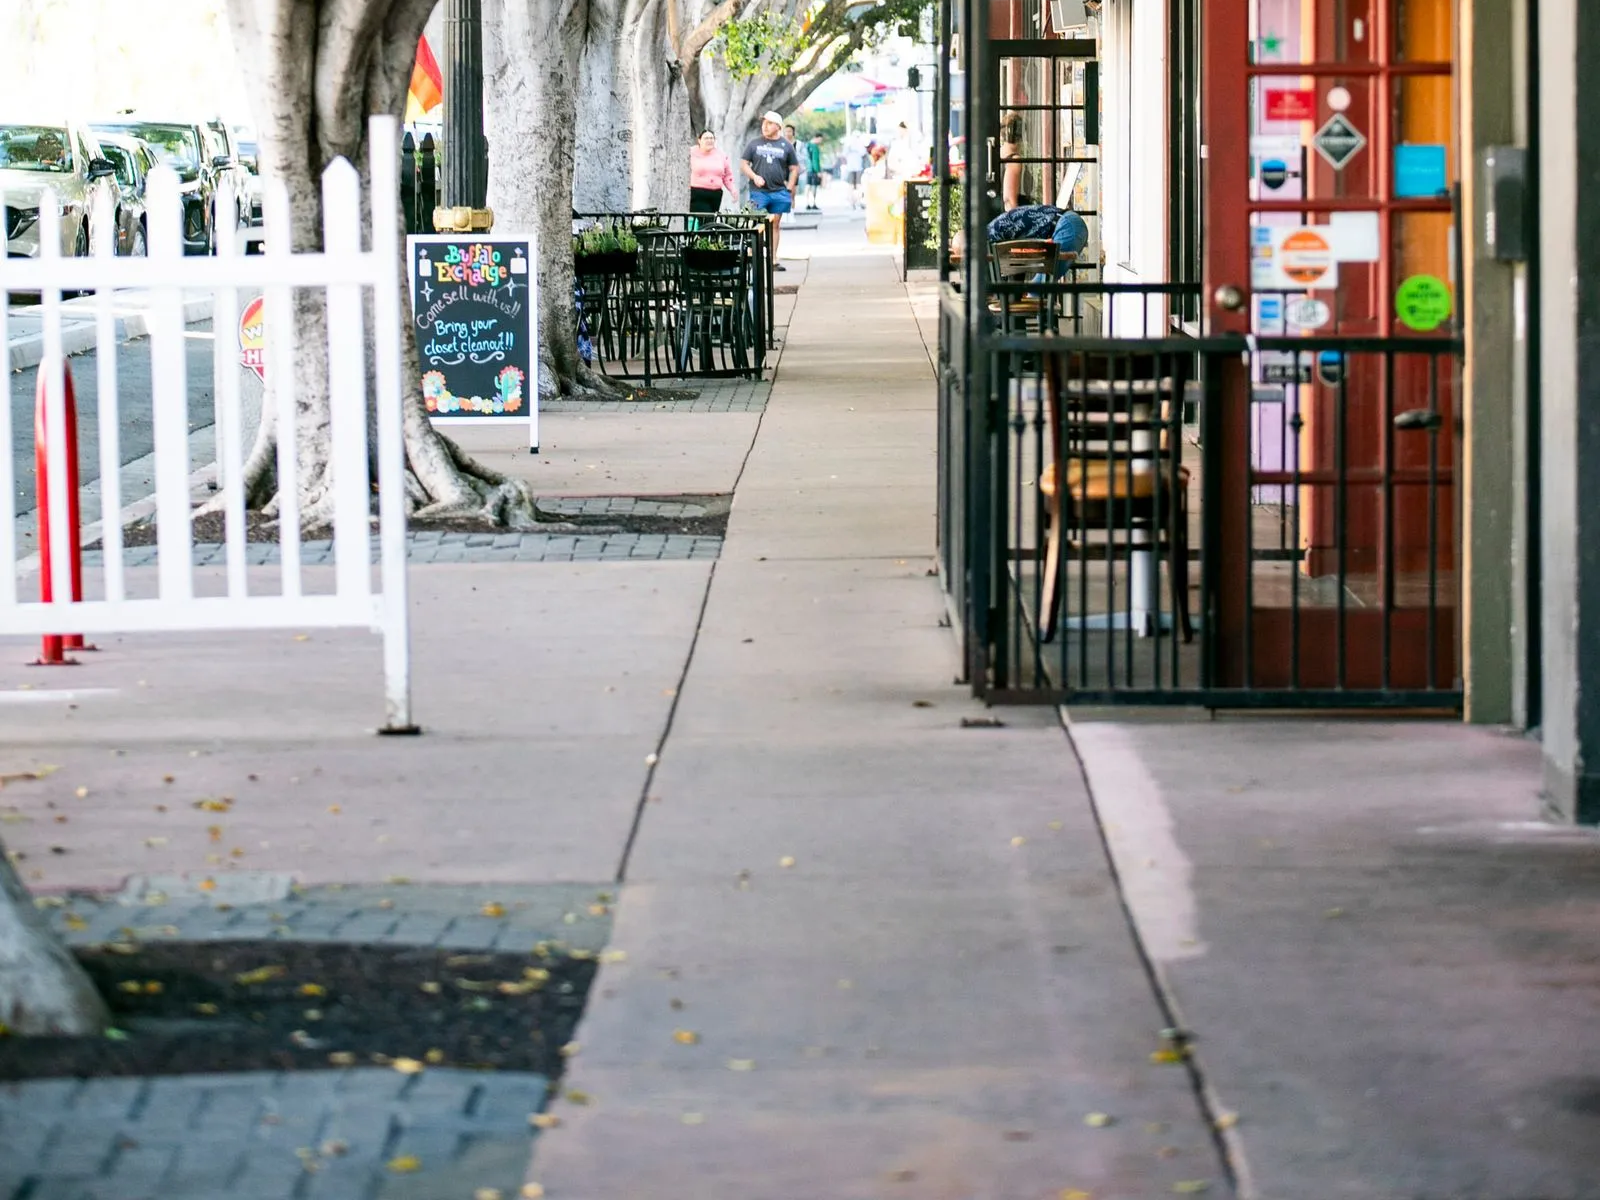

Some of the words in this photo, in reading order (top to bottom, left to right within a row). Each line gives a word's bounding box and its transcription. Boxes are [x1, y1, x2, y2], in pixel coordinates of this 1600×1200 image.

[444, 244, 501, 266] Buffalo
[434, 261, 507, 287] Exchange
[416, 299, 446, 329] Come
[442, 285, 469, 305] sell
[473, 288, 499, 307] with
[500, 300, 521, 319] us!!
[434, 319, 469, 339] Bring
[471, 318, 498, 337] your
[424, 335, 458, 356] closet
[460, 331, 514, 353] cleanout!!
